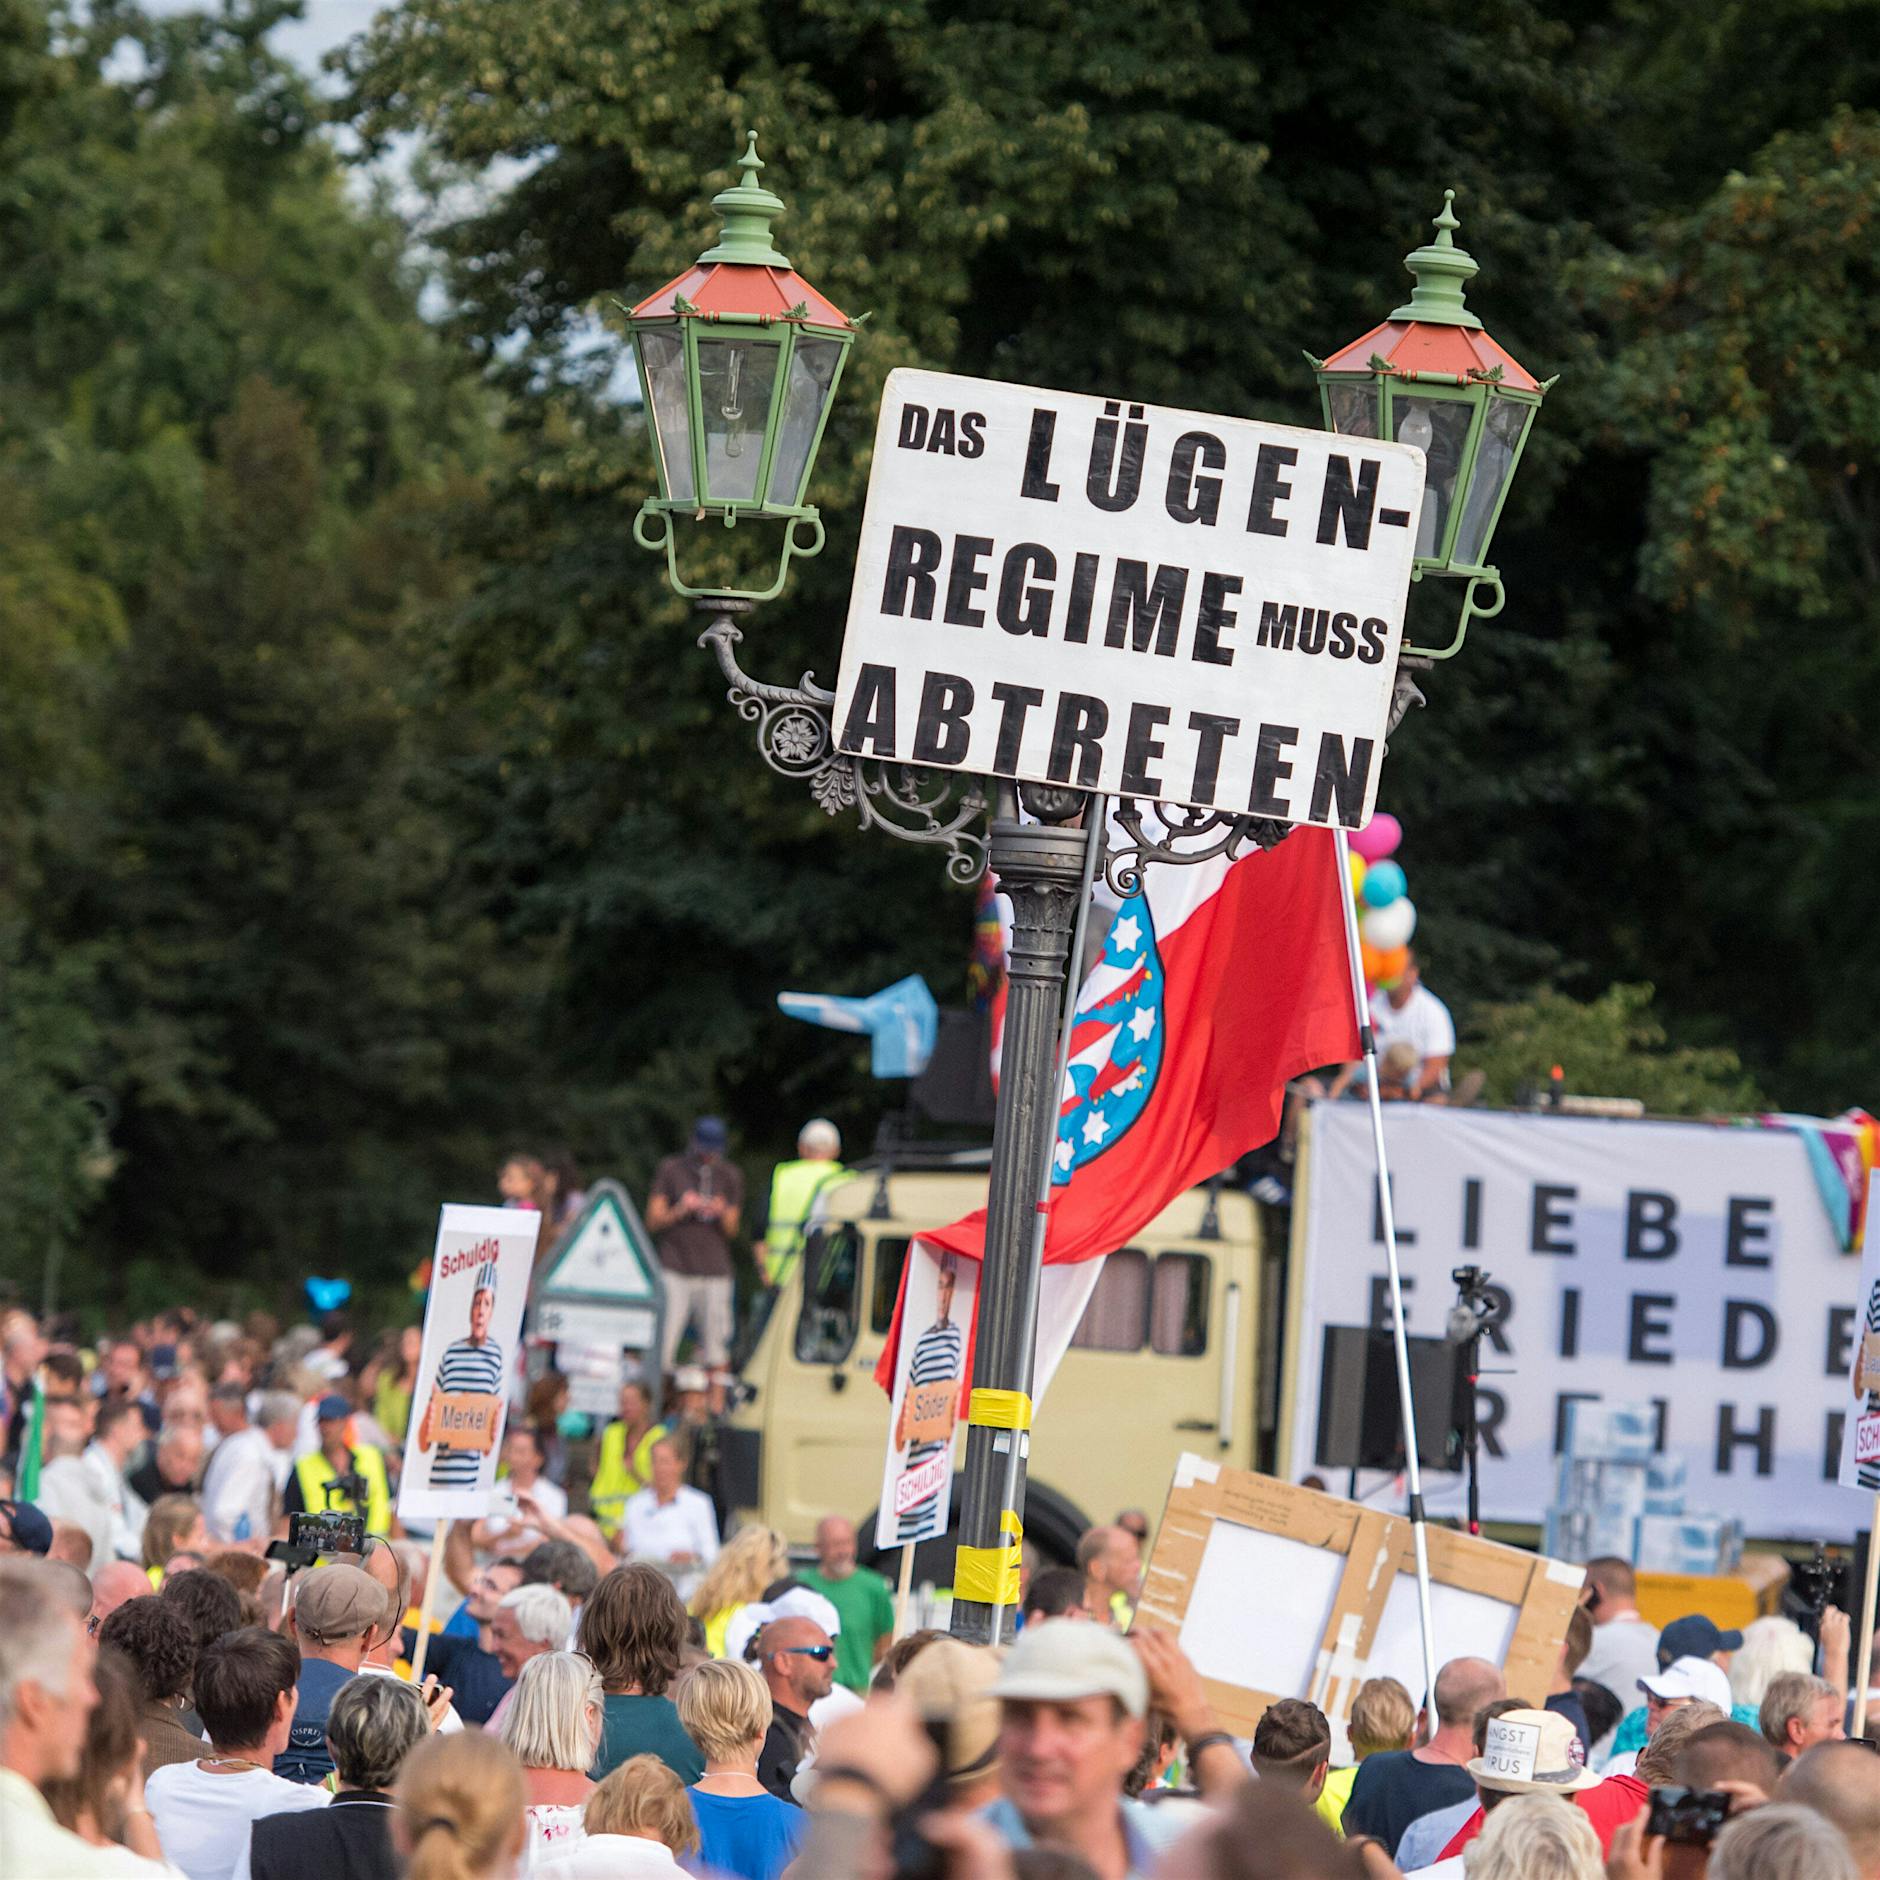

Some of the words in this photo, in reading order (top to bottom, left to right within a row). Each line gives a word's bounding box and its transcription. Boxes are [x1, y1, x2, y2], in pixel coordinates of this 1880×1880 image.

[898, 403, 986, 459] DAS
[1020, 401, 1410, 550] LÜGEN-
[880, 524, 1243, 667] REGIME
[1256, 601, 1388, 665] MUSS
[839, 662, 1374, 828] ABTRETEN
[440, 1237, 499, 1278] Schuldig
[1372, 1173, 1773, 1268] LIEBE
[441, 1405, 489, 1430] Merkel
[915, 1392, 948, 1421] Söder
